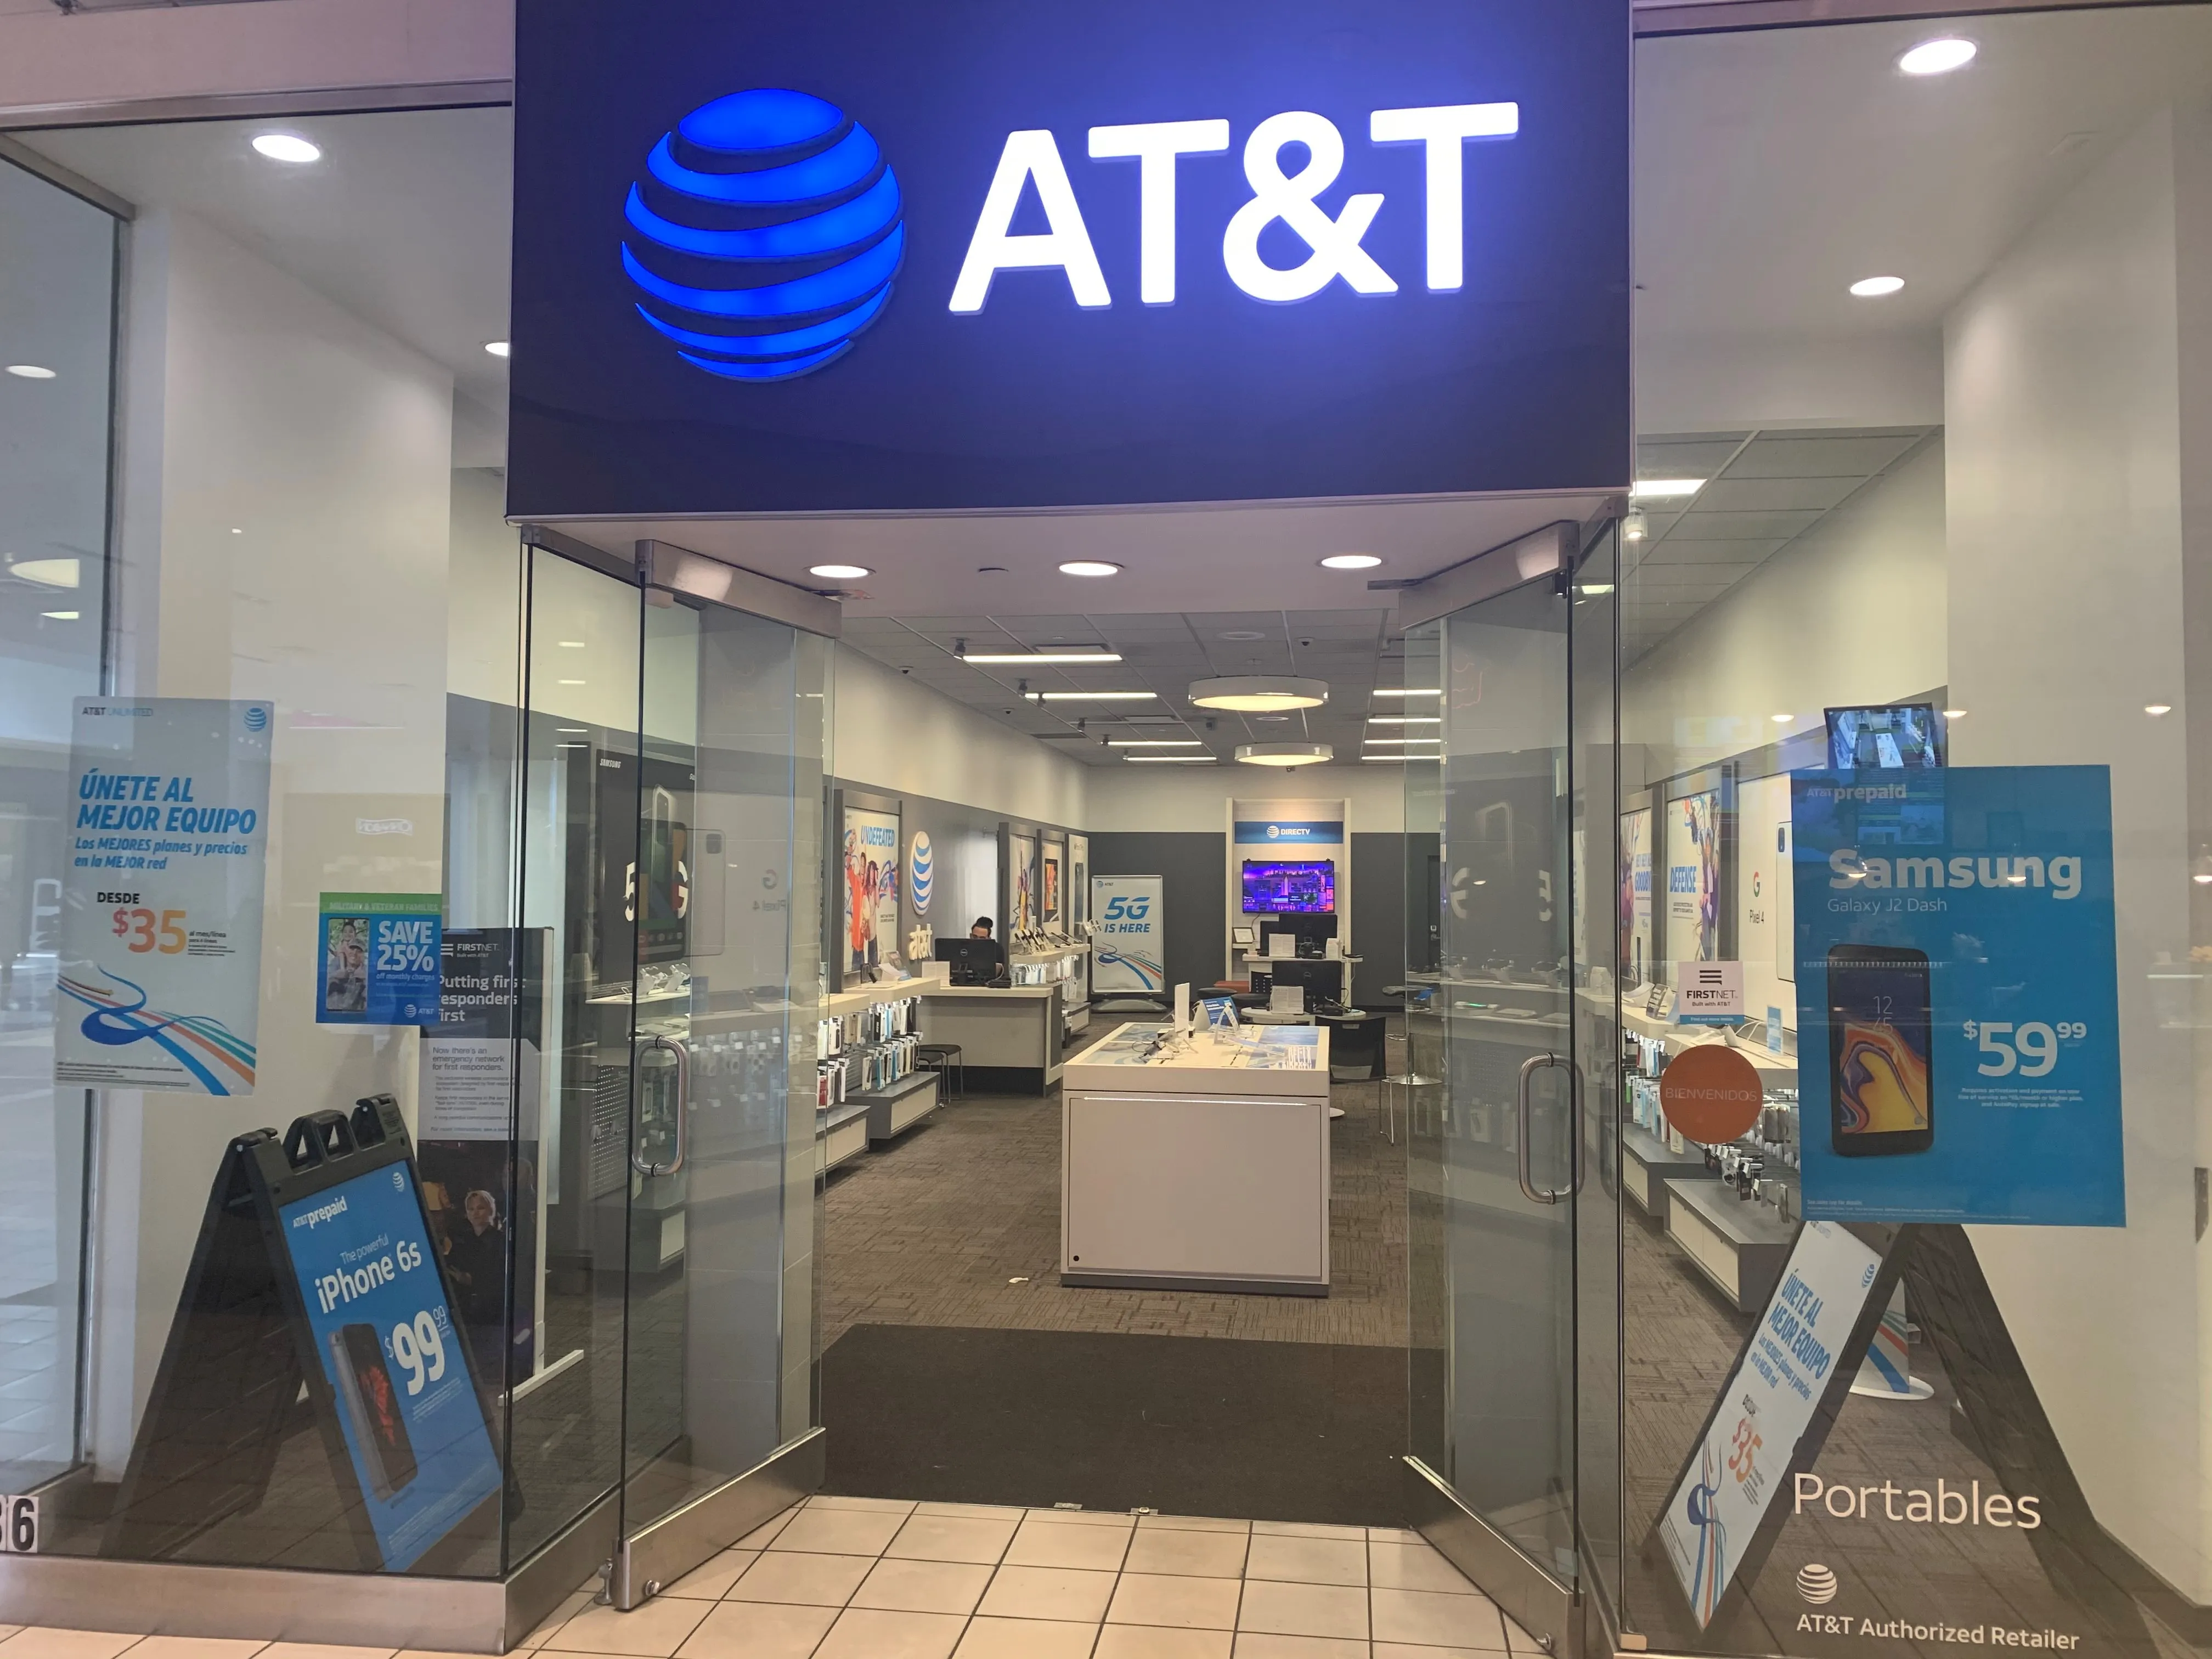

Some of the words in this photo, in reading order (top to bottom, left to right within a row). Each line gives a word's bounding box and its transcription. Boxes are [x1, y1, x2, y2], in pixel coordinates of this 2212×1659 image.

[949, 101, 1519, 314] AT&T
[82, 707, 106, 716] AT&T
[600, 758, 622, 769] SAMSUNG
[79, 768, 160, 800] ÚNETE
[162, 777, 194, 802] AL
[1807, 788, 1833, 797] AT&T
[1834, 783, 1907, 803] prepaid
[76, 805, 160, 831] MEJOR
[165, 807, 256, 834] EQUIPO
[75, 837, 94, 850] Los
[98, 838, 151, 851] MEJORES
[153, 840, 191, 855] planes
[193, 843, 202, 856] y
[204, 842, 247, 856] precios
[861, 825, 895, 848] UNDEFEATED
[75, 857, 89, 867] en
[92, 855, 101, 867] la
[104, 856, 145, 869] MEJOR
[146, 857, 167, 869] red
[1669, 866, 1697, 894] DEFENSE
[1829, 849, 2082, 900] Samsung
[97, 892, 140, 904] DESDE
[371, 903, 404, 911] VETERAN
[406, 904, 438, 912] FAMILIES
[1104, 896, 1150, 921] 5G
[1827, 898, 1881, 915] Galaxy
[1885, 898, 1903, 912] J2
[1908, 898, 1948, 912] Dash
[1104, 923, 1116, 933] IS
[1119, 923, 1151, 933] HERE
[1750, 909, 1760, 924] Pixel
[112, 907, 187, 954] $35
[378, 921, 433, 944] SAVE
[377, 944, 435, 972] 25%
[457, 943, 499, 952] FIRSTNET
[386, 973, 411, 981] monthly
[412, 973, 435, 982] charges
[439, 992, 518, 1007] esponders
[1686, 990, 1736, 999] FIRSTNET
[1872, 996, 1893, 1014] 12
[2056, 1022, 2087, 1039] 99
[460, 1064, 504, 1072] responders.
[1665, 1087, 1757, 1102] BIENVENIDOS
[307, 1195, 348, 1229] prepaid
[340, 1251, 357, 1265] The
[357, 1233, 389, 1261] powerful
[314, 1255, 396, 1314] iPhone
[396, 1240, 422, 1272] 6s
[1781, 1268, 1814, 1317] ÚNETE
[1803, 1297, 1824, 1329] AL
[433, 1305, 448, 1328] 99
[1768, 1301, 1801, 1348] MEJOR
[1791, 1327, 1831, 1380] EQUIPO
[1795, 1472, 2041, 1529] Portables
[0, 1498, 35, 1552] 6
[1796, 1613, 1854, 1635] AT&T
[1859, 1618, 1985, 1644] Authorized
[1991, 1627, 2080, 1651] Retailer
